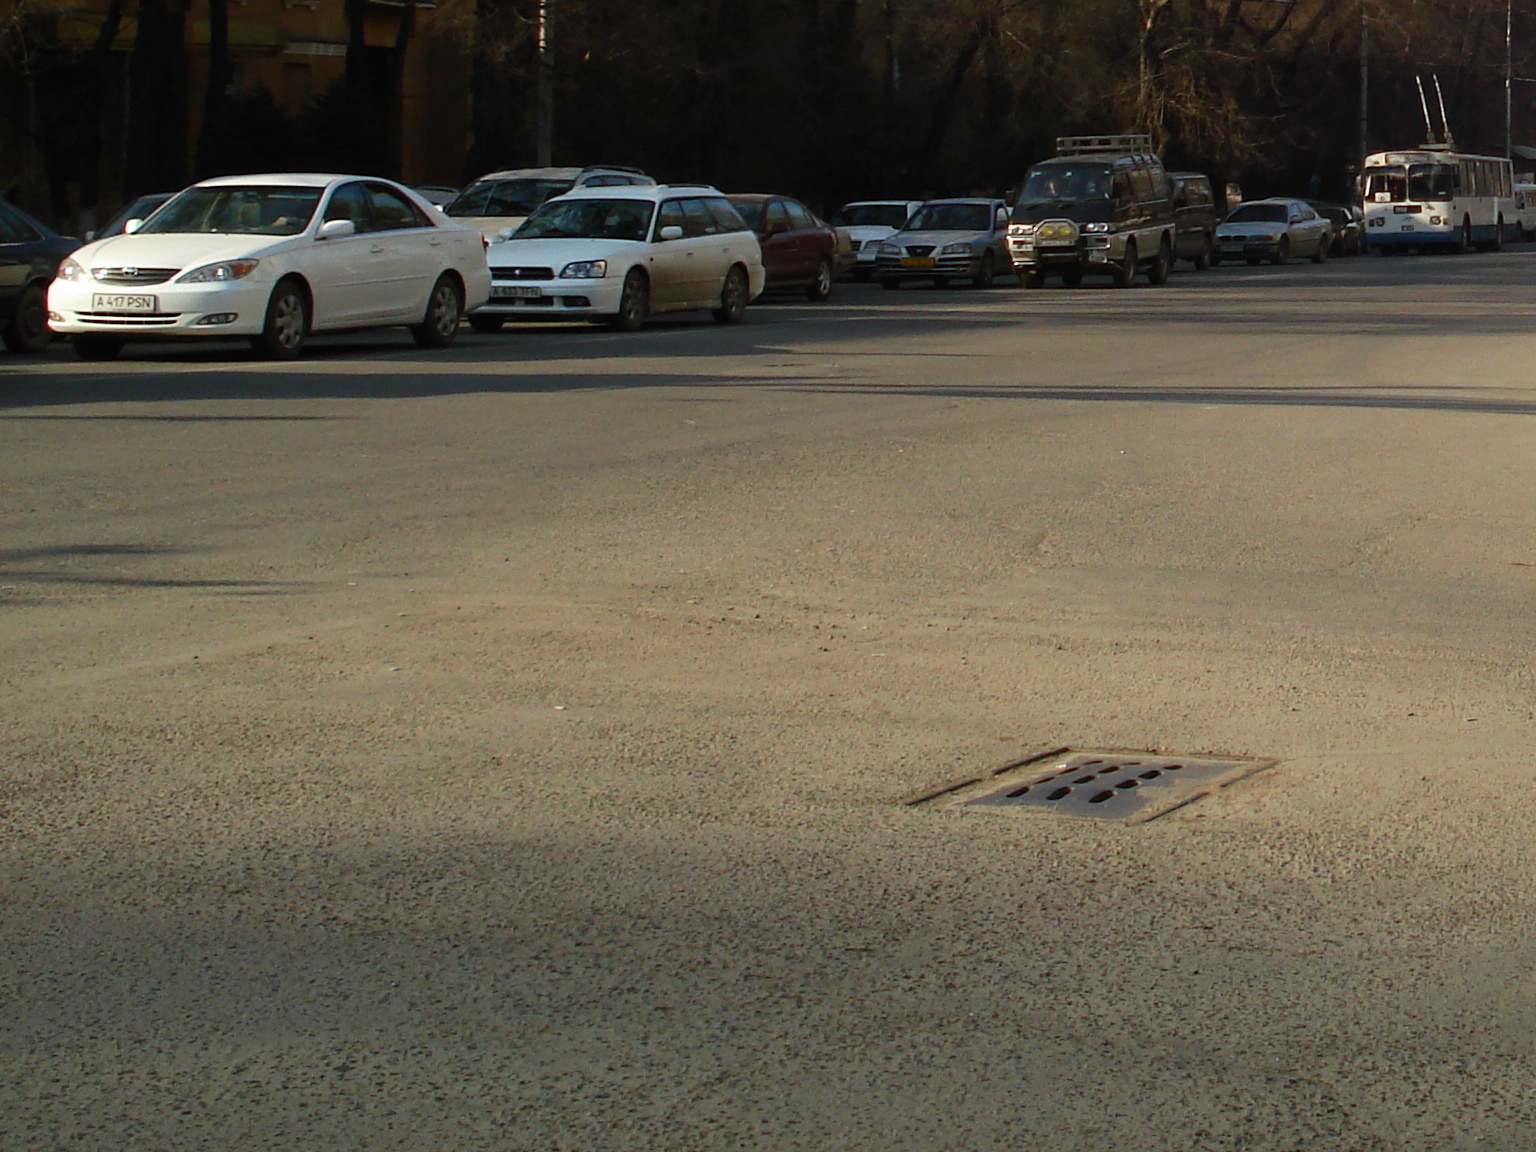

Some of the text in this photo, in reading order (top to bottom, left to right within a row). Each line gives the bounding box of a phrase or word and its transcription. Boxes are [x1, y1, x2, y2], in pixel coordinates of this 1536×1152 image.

[97, 296, 151, 308] A 417 PSN
